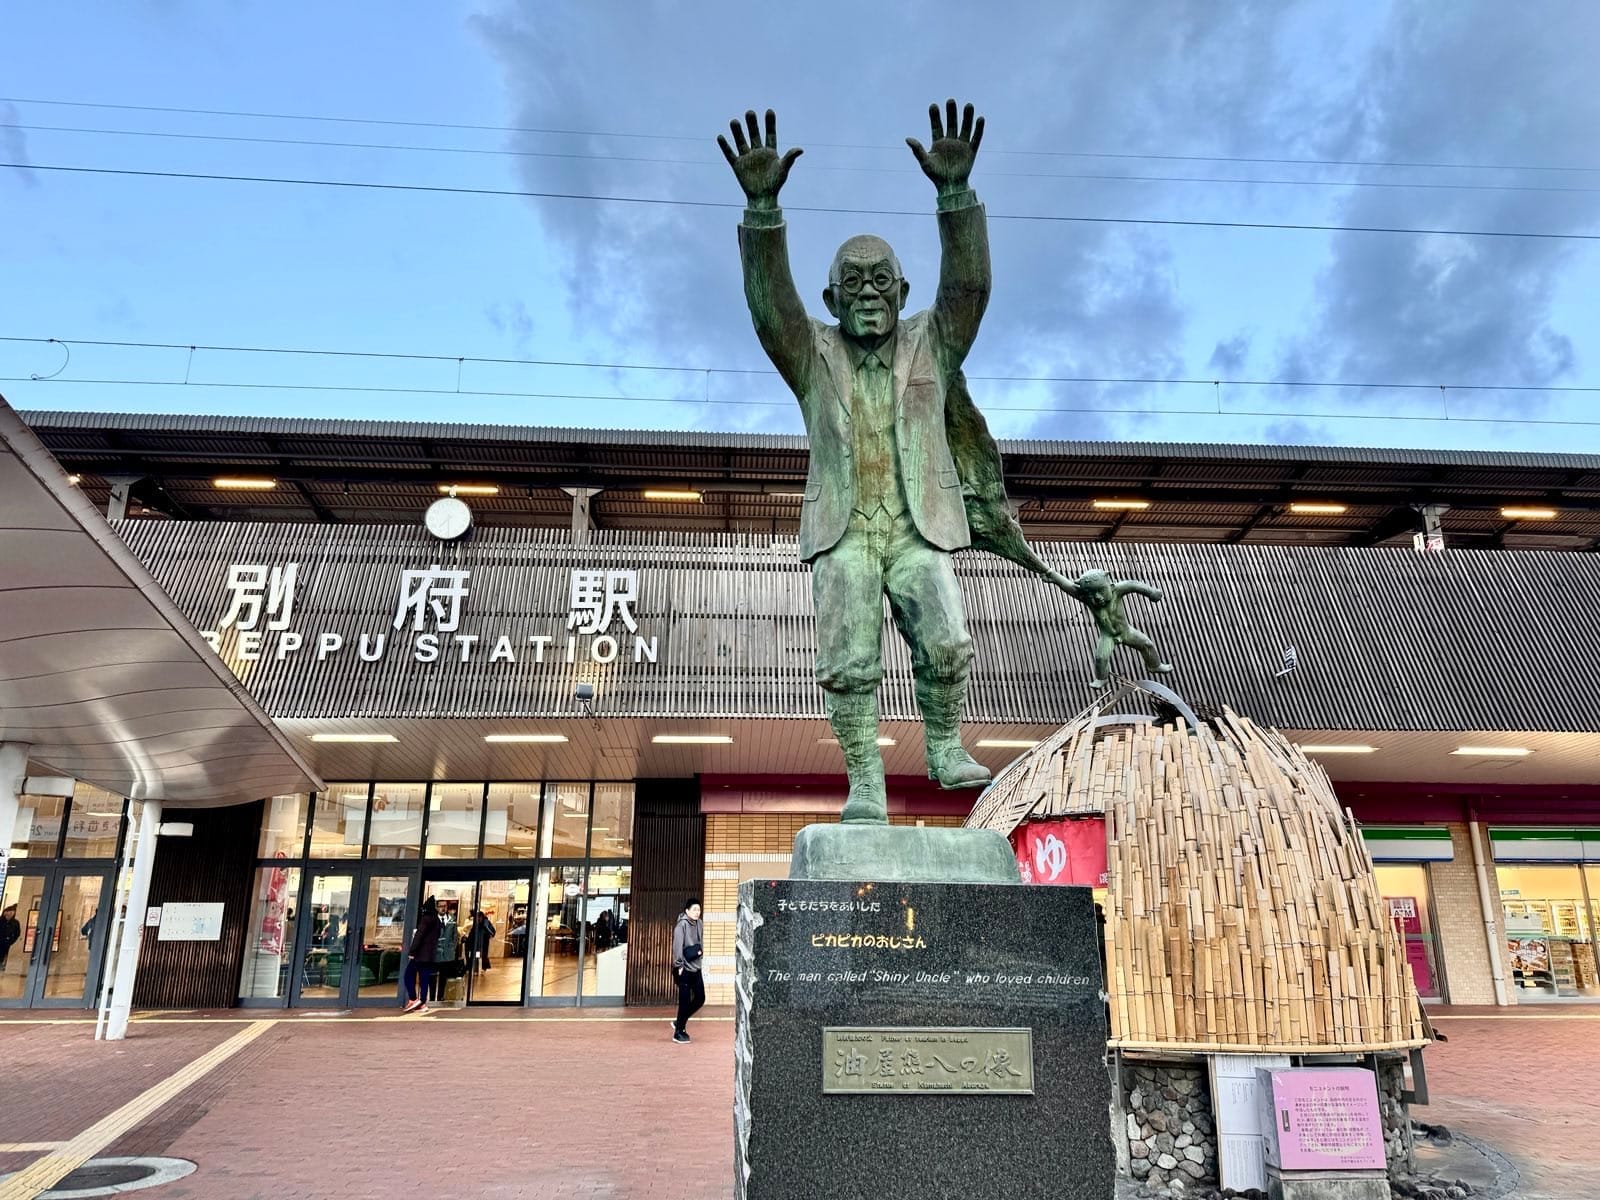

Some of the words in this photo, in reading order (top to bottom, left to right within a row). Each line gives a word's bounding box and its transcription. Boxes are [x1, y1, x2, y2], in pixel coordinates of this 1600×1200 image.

[221, 563, 638, 634] 別府駅
[414, 634, 658, 662] STATION
[1035, 833, 1067, 881] ゆ
[777, 900, 881, 912] 子どもたちをあいした
[811, 933, 927, 949] ピカピカのおじさん
[767, 969, 791, 981] The
[797, 972, 821, 981] man
[827, 970, 867, 982] called
[965, 974, 990, 984] who
[995, 973, 1032, 984] loved
[1037, 974, 1090, 985] children
